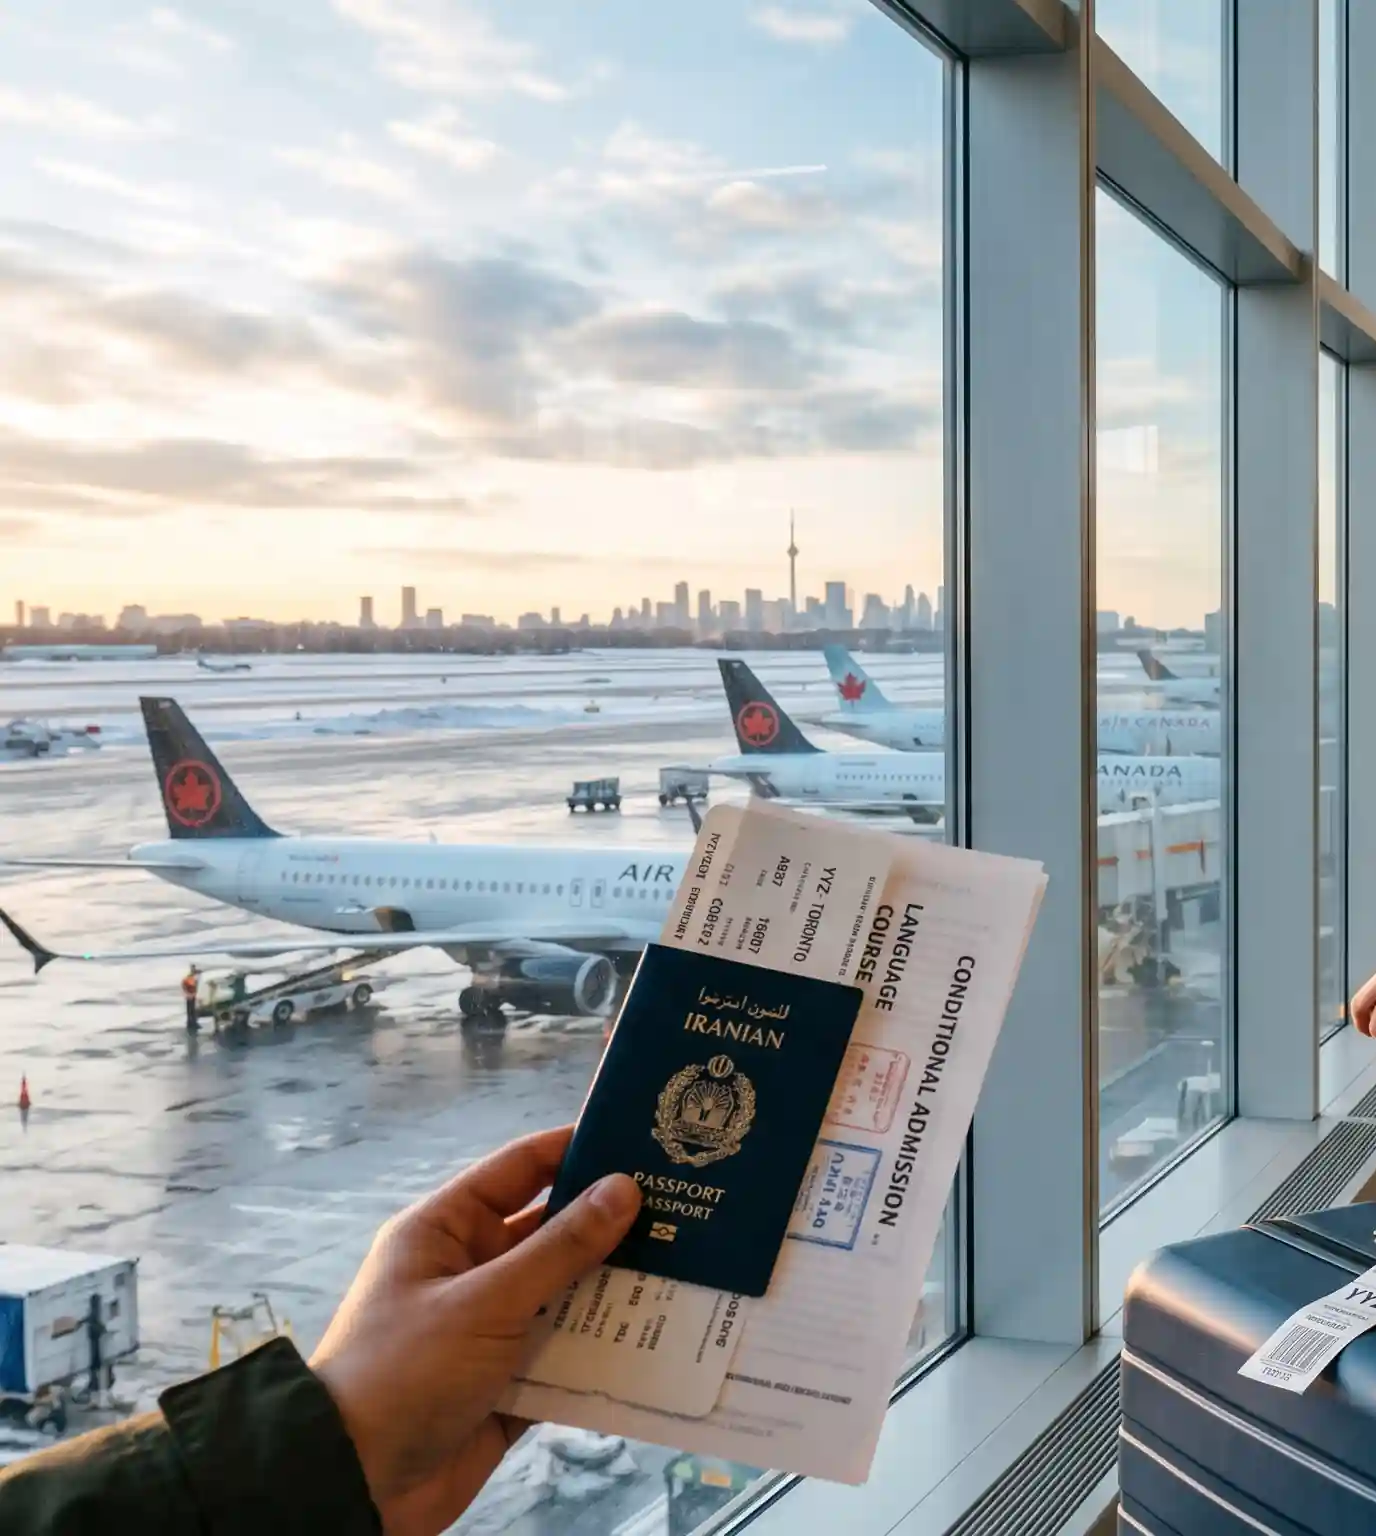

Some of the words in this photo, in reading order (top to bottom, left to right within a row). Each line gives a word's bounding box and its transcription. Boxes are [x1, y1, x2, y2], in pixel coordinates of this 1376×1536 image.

[1096, 764, 1182, 778] ANADA
[618, 864, 675, 883] AIR
[793, 903, 825, 963] TORONTO
[855, 904, 894, 983] COURSE
[875, 903, 924, 1011] LANGUAGE
[684, 1012, 785, 1049] IRANIAN
[917, 955, 976, 1096] CONDITIONAL
[634, 1171, 726, 1203] PASSPORT
[878, 1102, 931, 1227] ADMISSION
[644, 1195, 714, 1220] ASSPORT
